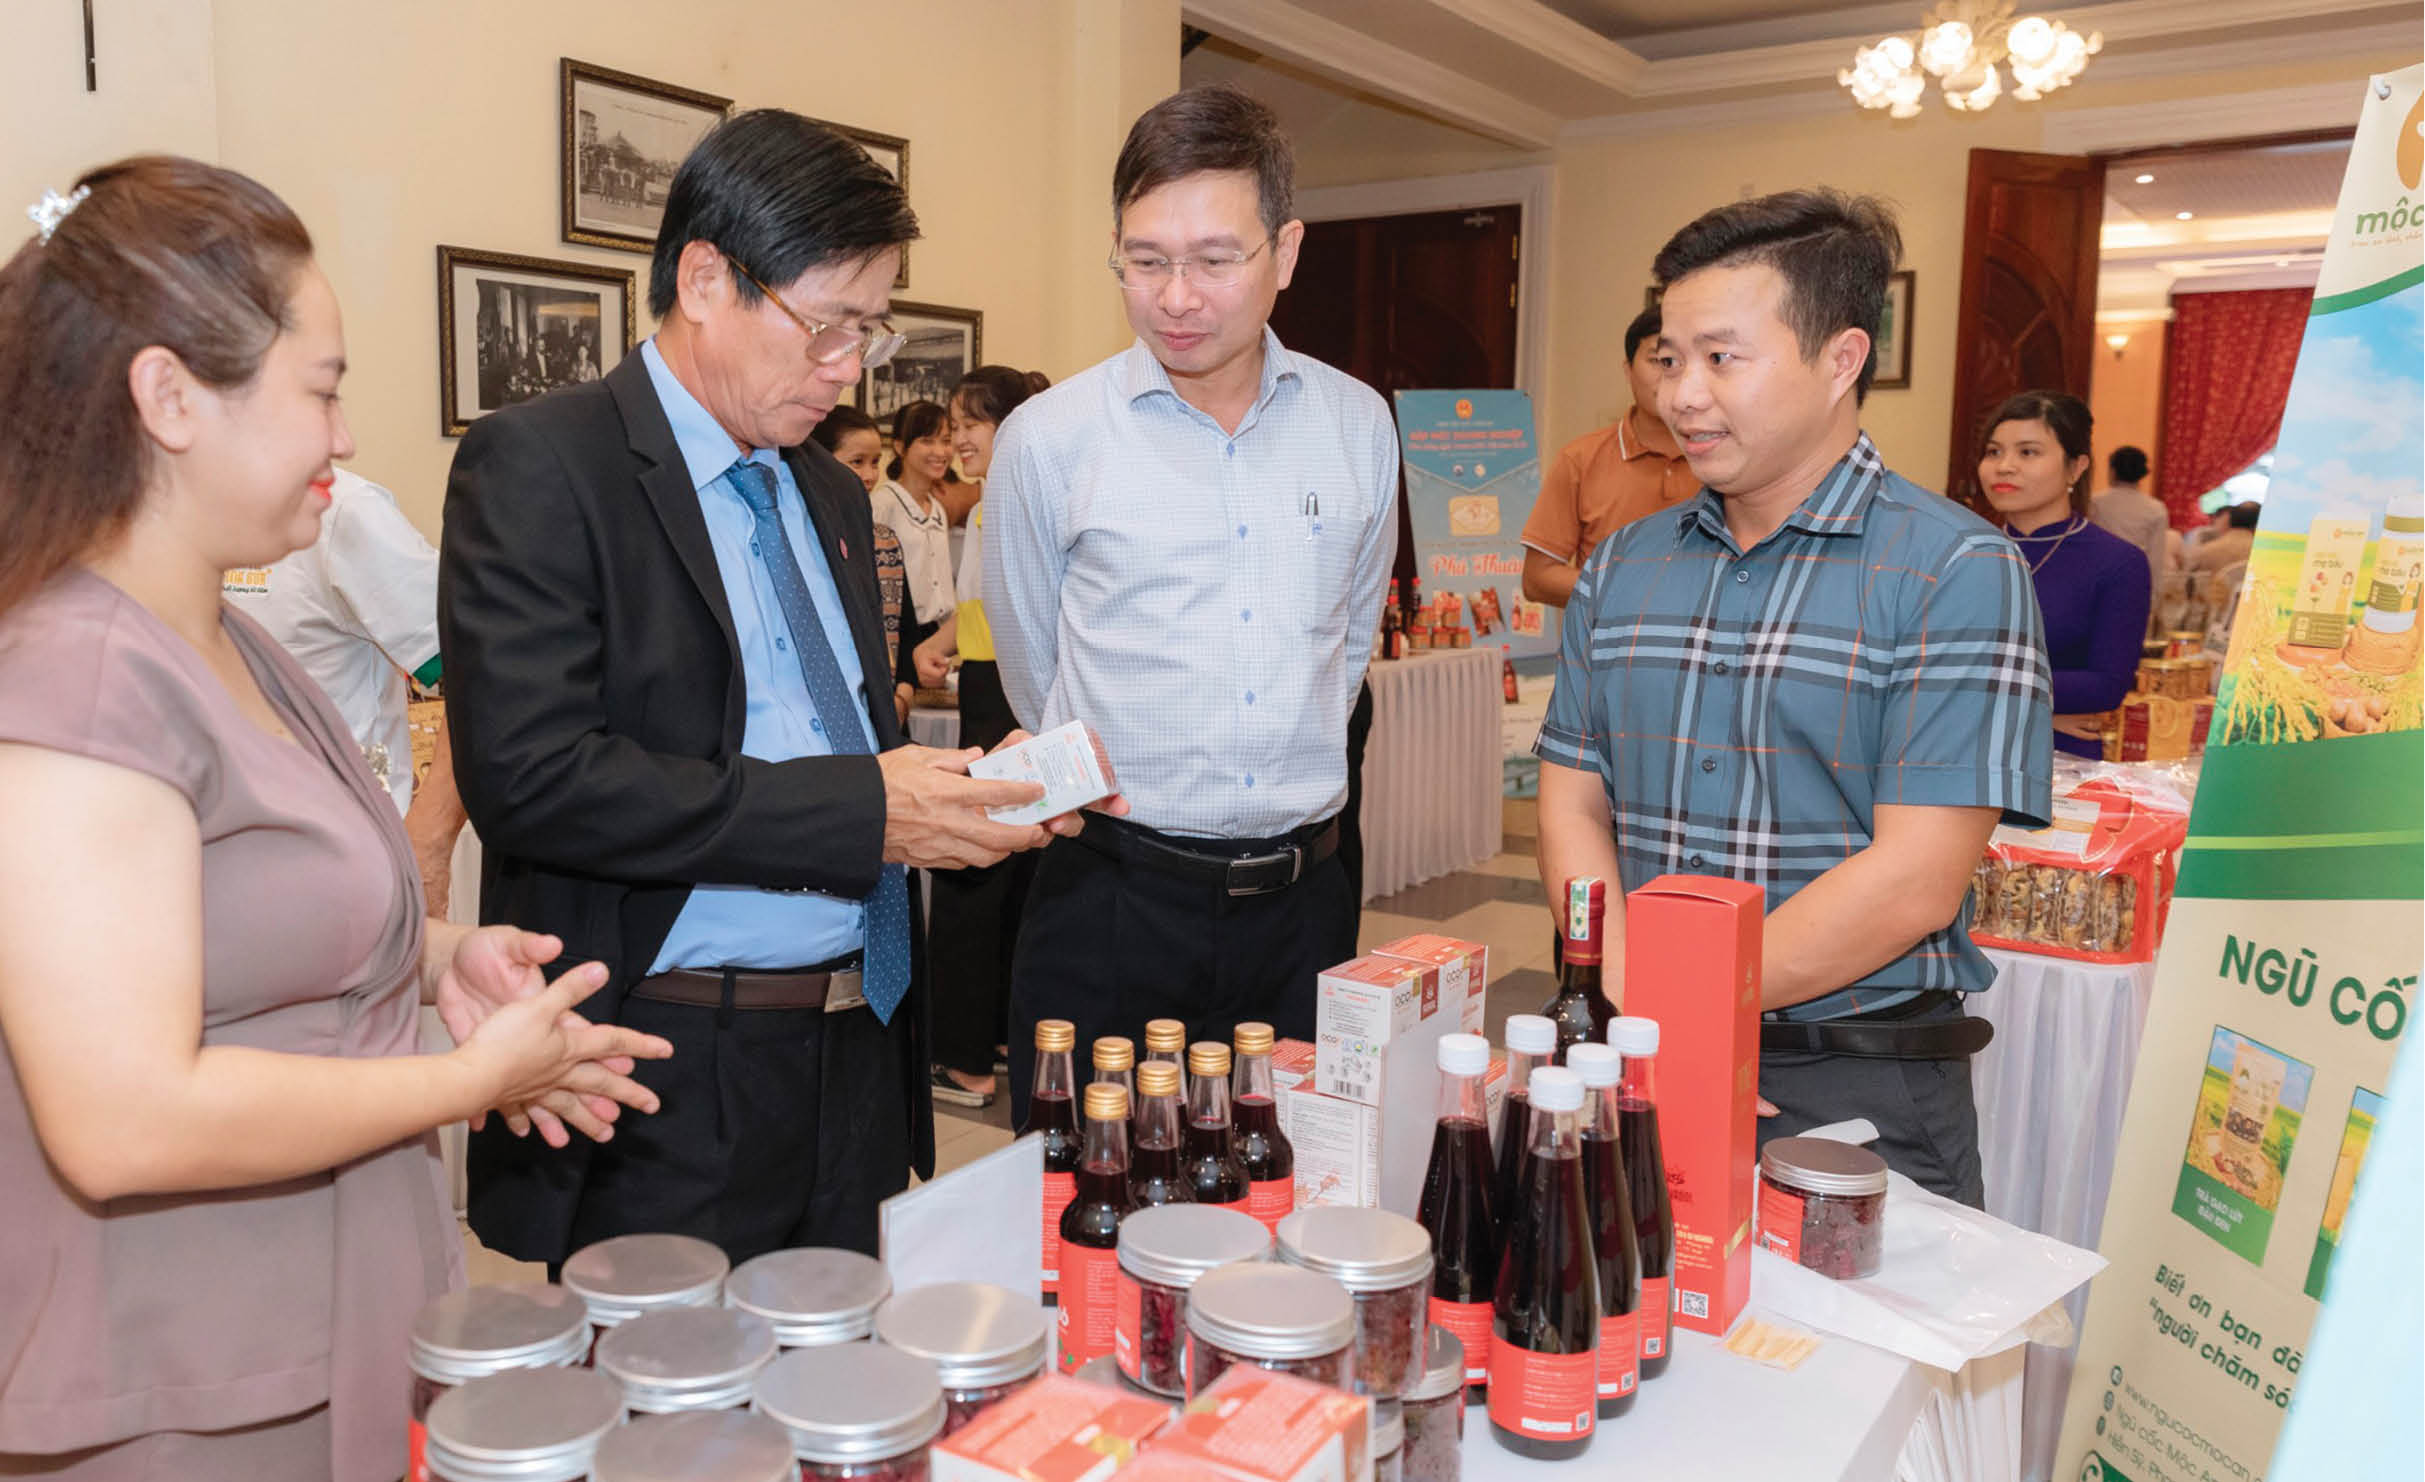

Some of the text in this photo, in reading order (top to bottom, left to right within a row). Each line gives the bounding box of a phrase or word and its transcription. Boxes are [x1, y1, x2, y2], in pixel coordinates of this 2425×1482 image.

[2219, 934, 2319, 1008] NGŨ
[2155, 1264, 2187, 1297] Biết
[2219, 1310, 2263, 1349] bạn
[2200, 1343, 2261, 1390] chăm
[2264, 1383, 2294, 1409] só
